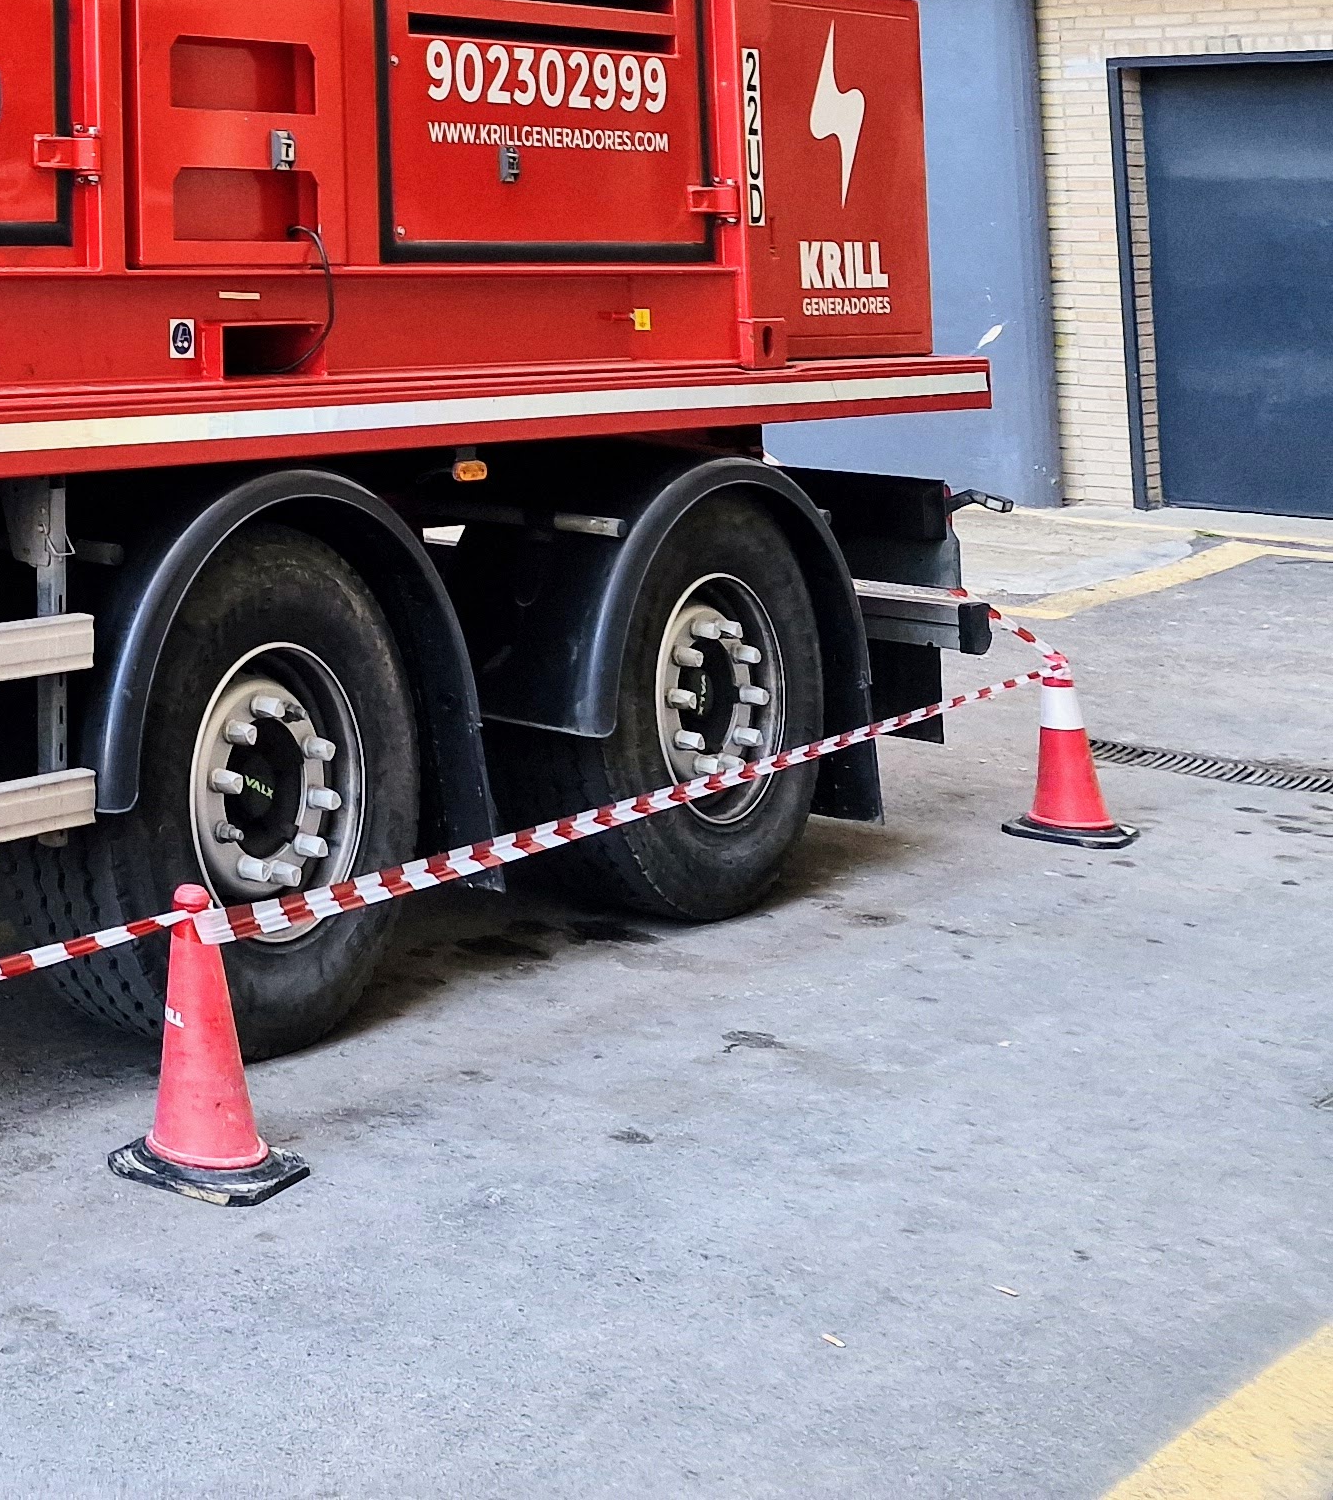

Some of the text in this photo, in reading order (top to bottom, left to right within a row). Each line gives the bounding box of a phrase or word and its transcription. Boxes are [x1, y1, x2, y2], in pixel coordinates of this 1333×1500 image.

[426, 39, 667, 113] 902302999
[428, 121, 669, 153] WWW.KRILLGENERADORES.COM
[745, 51, 763, 224] 22UD
[798, 240, 889, 289] KRILL
[802, 296, 891, 316] GENERADORES
[245, 774, 274, 800] VALX
